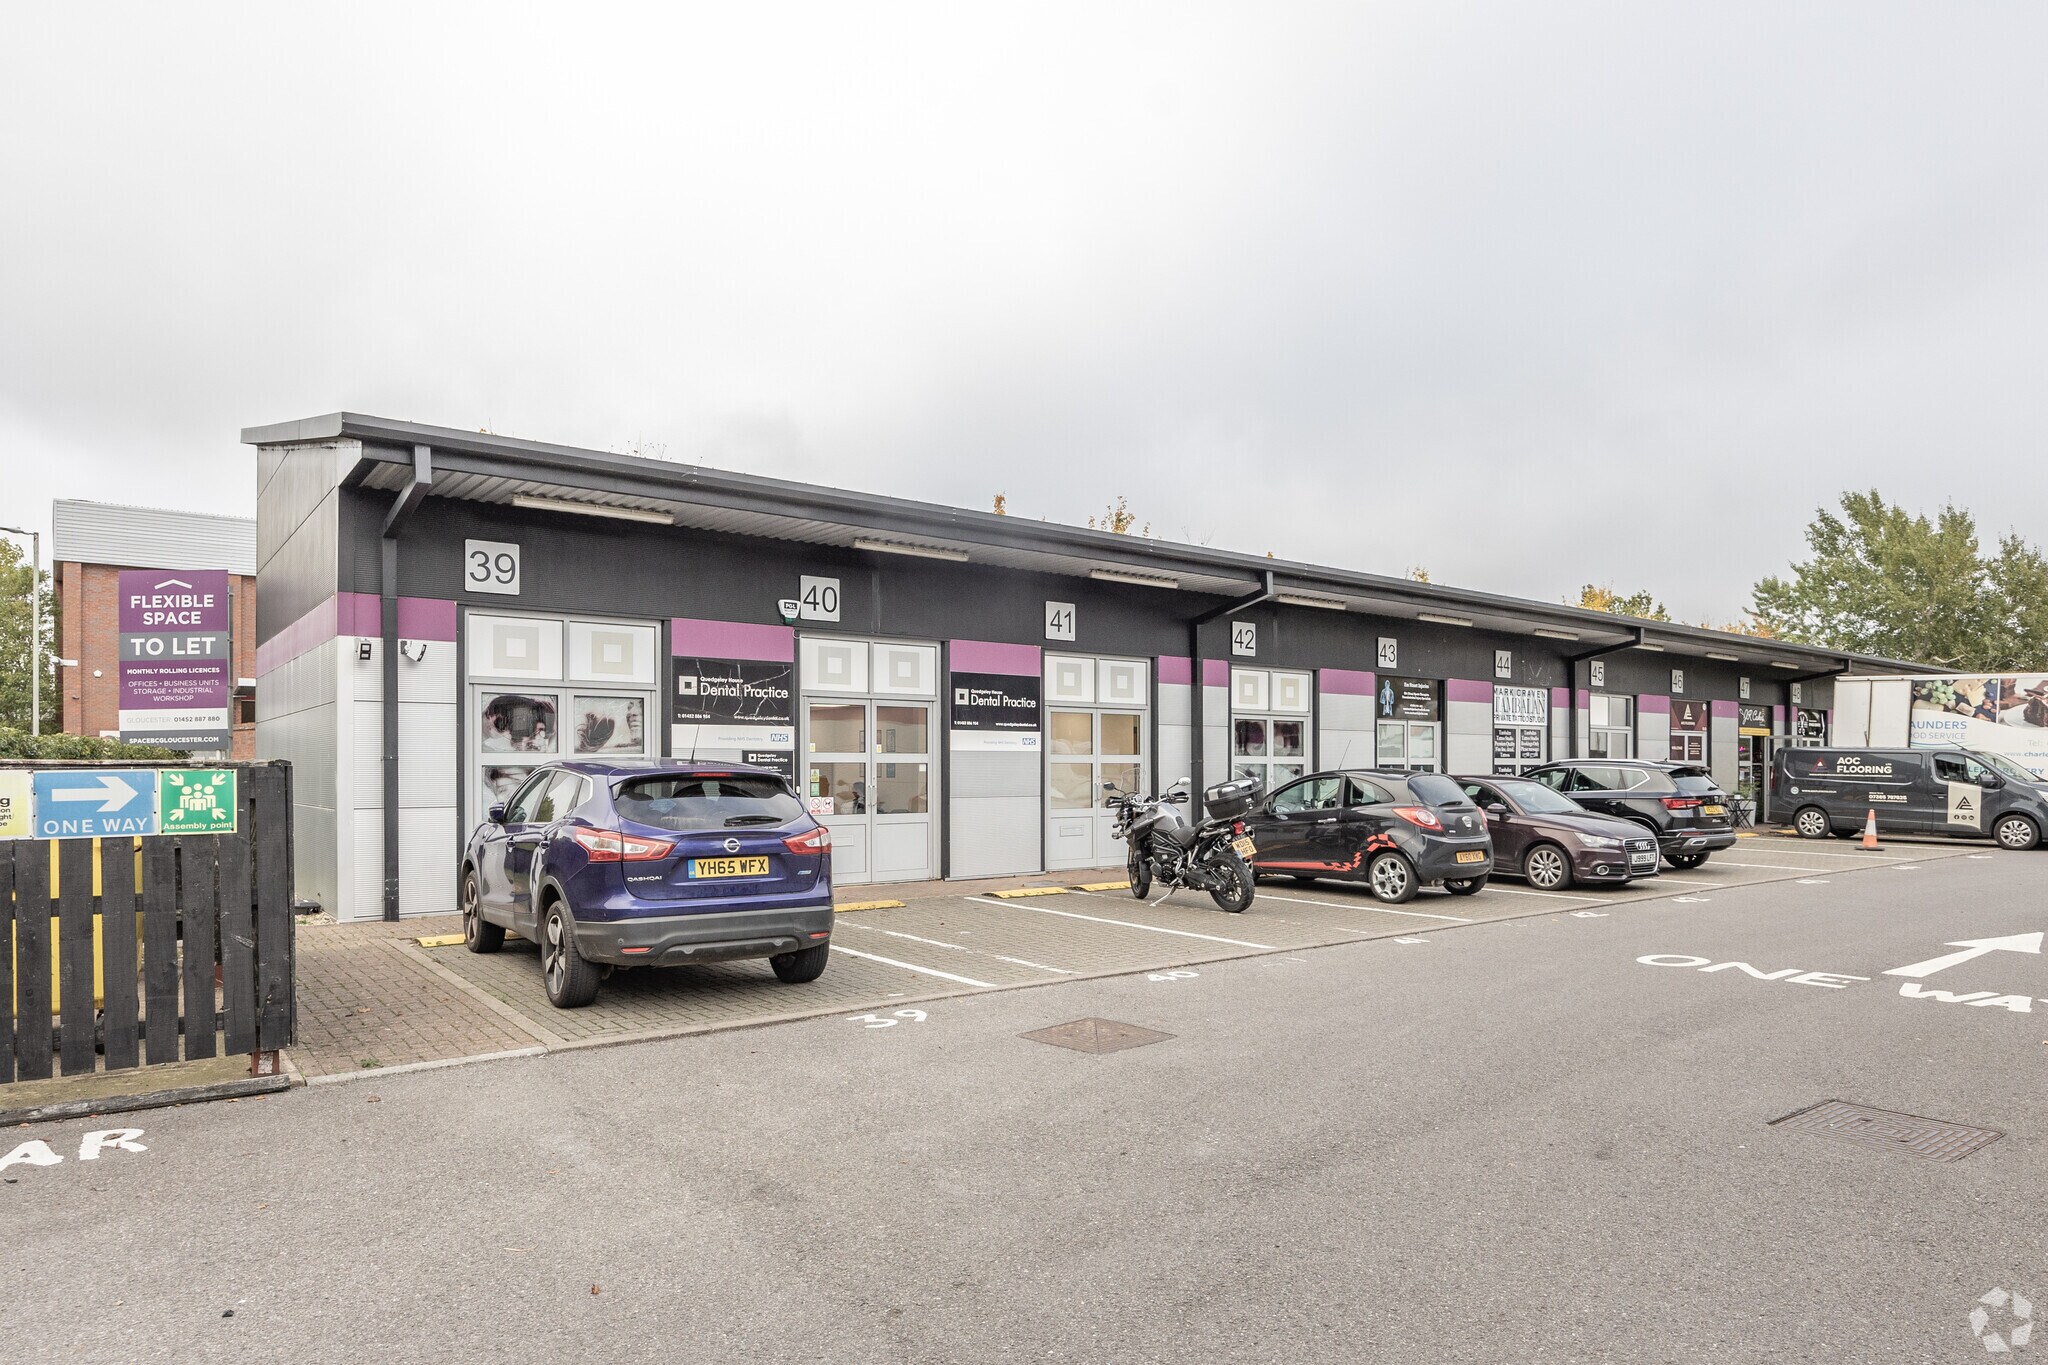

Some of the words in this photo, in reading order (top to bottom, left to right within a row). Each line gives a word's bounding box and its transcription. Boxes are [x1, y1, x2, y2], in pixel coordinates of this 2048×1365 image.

[469, 550, 516, 584] 39
[130, 594, 214, 609] FLEXIBLE
[803, 585, 837, 613] 40
[143, 611, 202, 625] SPACE
[1050, 610, 1071, 633] 41
[130, 638, 164, 656] TO
[172, 637, 216, 655] LET
[1234, 629, 1254, 650] 42
[1380, 644, 1396, 662] 43
[1497, 656, 1510, 672] 44
[1592, 666, 1604, 681] 45
[1673, 674, 1683, 689] 46
[700, 682, 740, 696] Dental
[743, 684, 789, 699] Practice
[970, 694, 1000, 706] Dental
[1003, 696, 1036, 708] Practice
[771, 734, 788, 742] NHS
[1928, 732, 1966, 740] SERVICE
[1837, 757, 1861, 765] AOC
[1837, 765, 1893, 774] FLOORING
[43, 819, 94, 834] ONE
[102, 817, 148, 832] WAY
[163, 822, 207, 831] Assembly
[210, 821, 233, 830] point
[698, 861, 736, 875] YH65
[740, 859, 766, 873] WFX
[1147, 971, 1200, 981] 40
[1636, 954, 1871, 989] ONE
[1899, 983, 2048, 1013] WA
[846, 1009, 927, 1029] 39
